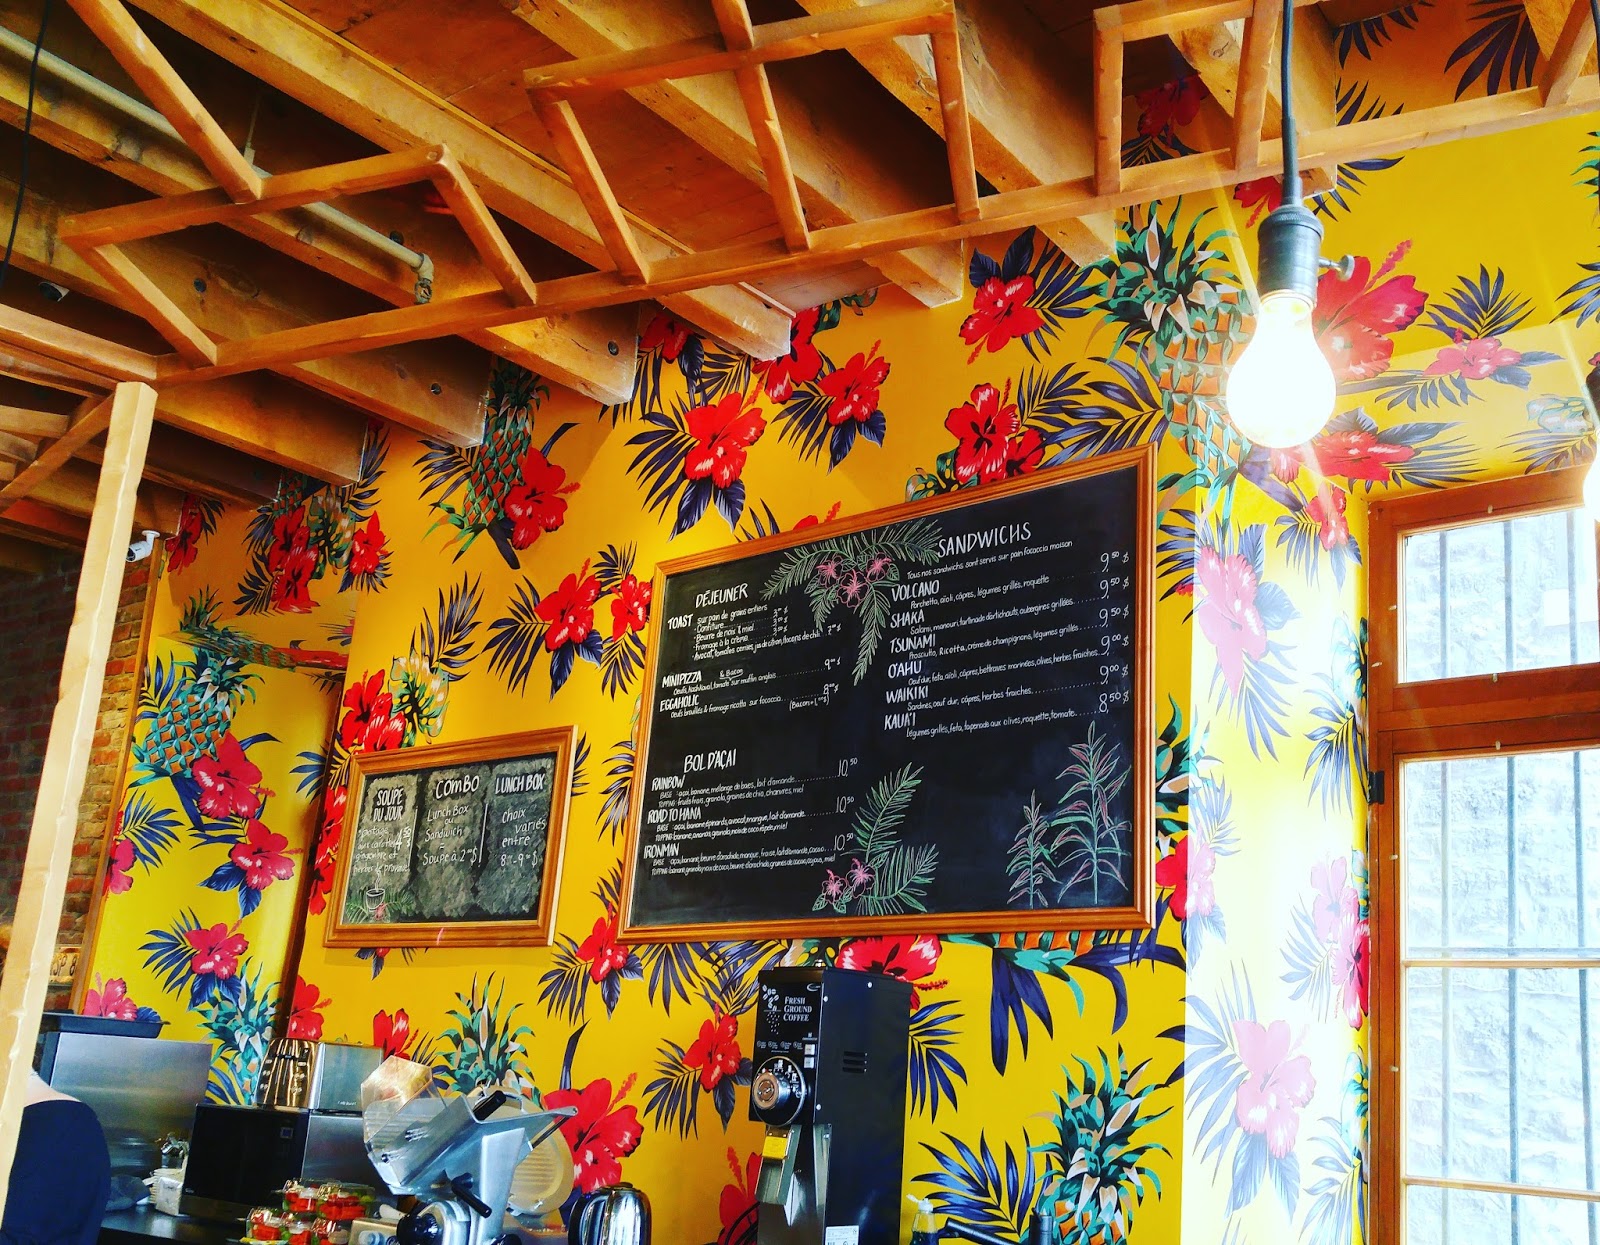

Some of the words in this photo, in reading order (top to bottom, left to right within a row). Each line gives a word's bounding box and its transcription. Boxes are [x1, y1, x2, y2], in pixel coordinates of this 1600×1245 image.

[938, 521, 1032, 558] SANDWICHS
[907, 571, 921, 580] Tous
[921, 569, 931, 577] nos
[933, 562, 964, 576] sandwichs
[965, 557, 979, 568] sont
[980, 555, 997, 565] servis
[998, 553, 1009, 561] sur
[1010, 550, 1023, 562] pain
[1023, 546, 1049, 556] focaccia
[1049, 540, 1073, 551] maison
[1022, 573, 1050, 589] roquette
[695, 583, 748, 609] DÉJEUNER
[891, 579, 940, 603] VOLCANO
[667, 613, 693, 631] TOAST
[890, 609, 925, 629] SHAKA
[890, 633, 936, 654] TSUNAMI
[728, 668, 743, 677] Bacon
[660, 694, 700, 713] EGGAHOLIC
[885, 684, 930, 705] WAIKIKI
[683, 753, 707, 774] BOL
[495, 775, 525, 795] LUNCH
[526, 772, 546, 792] BOX
[651, 774, 686, 792] RAINBOW
[377, 787, 405, 806] SOUPE
[373, 806, 384, 822] DU
[384, 805, 404, 822] JOUR
[427, 808, 452, 822] Lunch
[452, 804, 470, 817] Box
[444, 817, 454, 825] ou
[647, 808, 669, 824] ROAD
[668, 808, 679, 822] TO
[679, 806, 702, 822] HANA
[424, 827, 463, 842] Sandwich
[515, 817, 547, 834] variés
[501, 834, 531, 848] entre
[784, 995, 806, 1005] FRESH
[782, 1013, 810, 1022] COFFEE
[783, 1005, 813, 1014] GROUND
